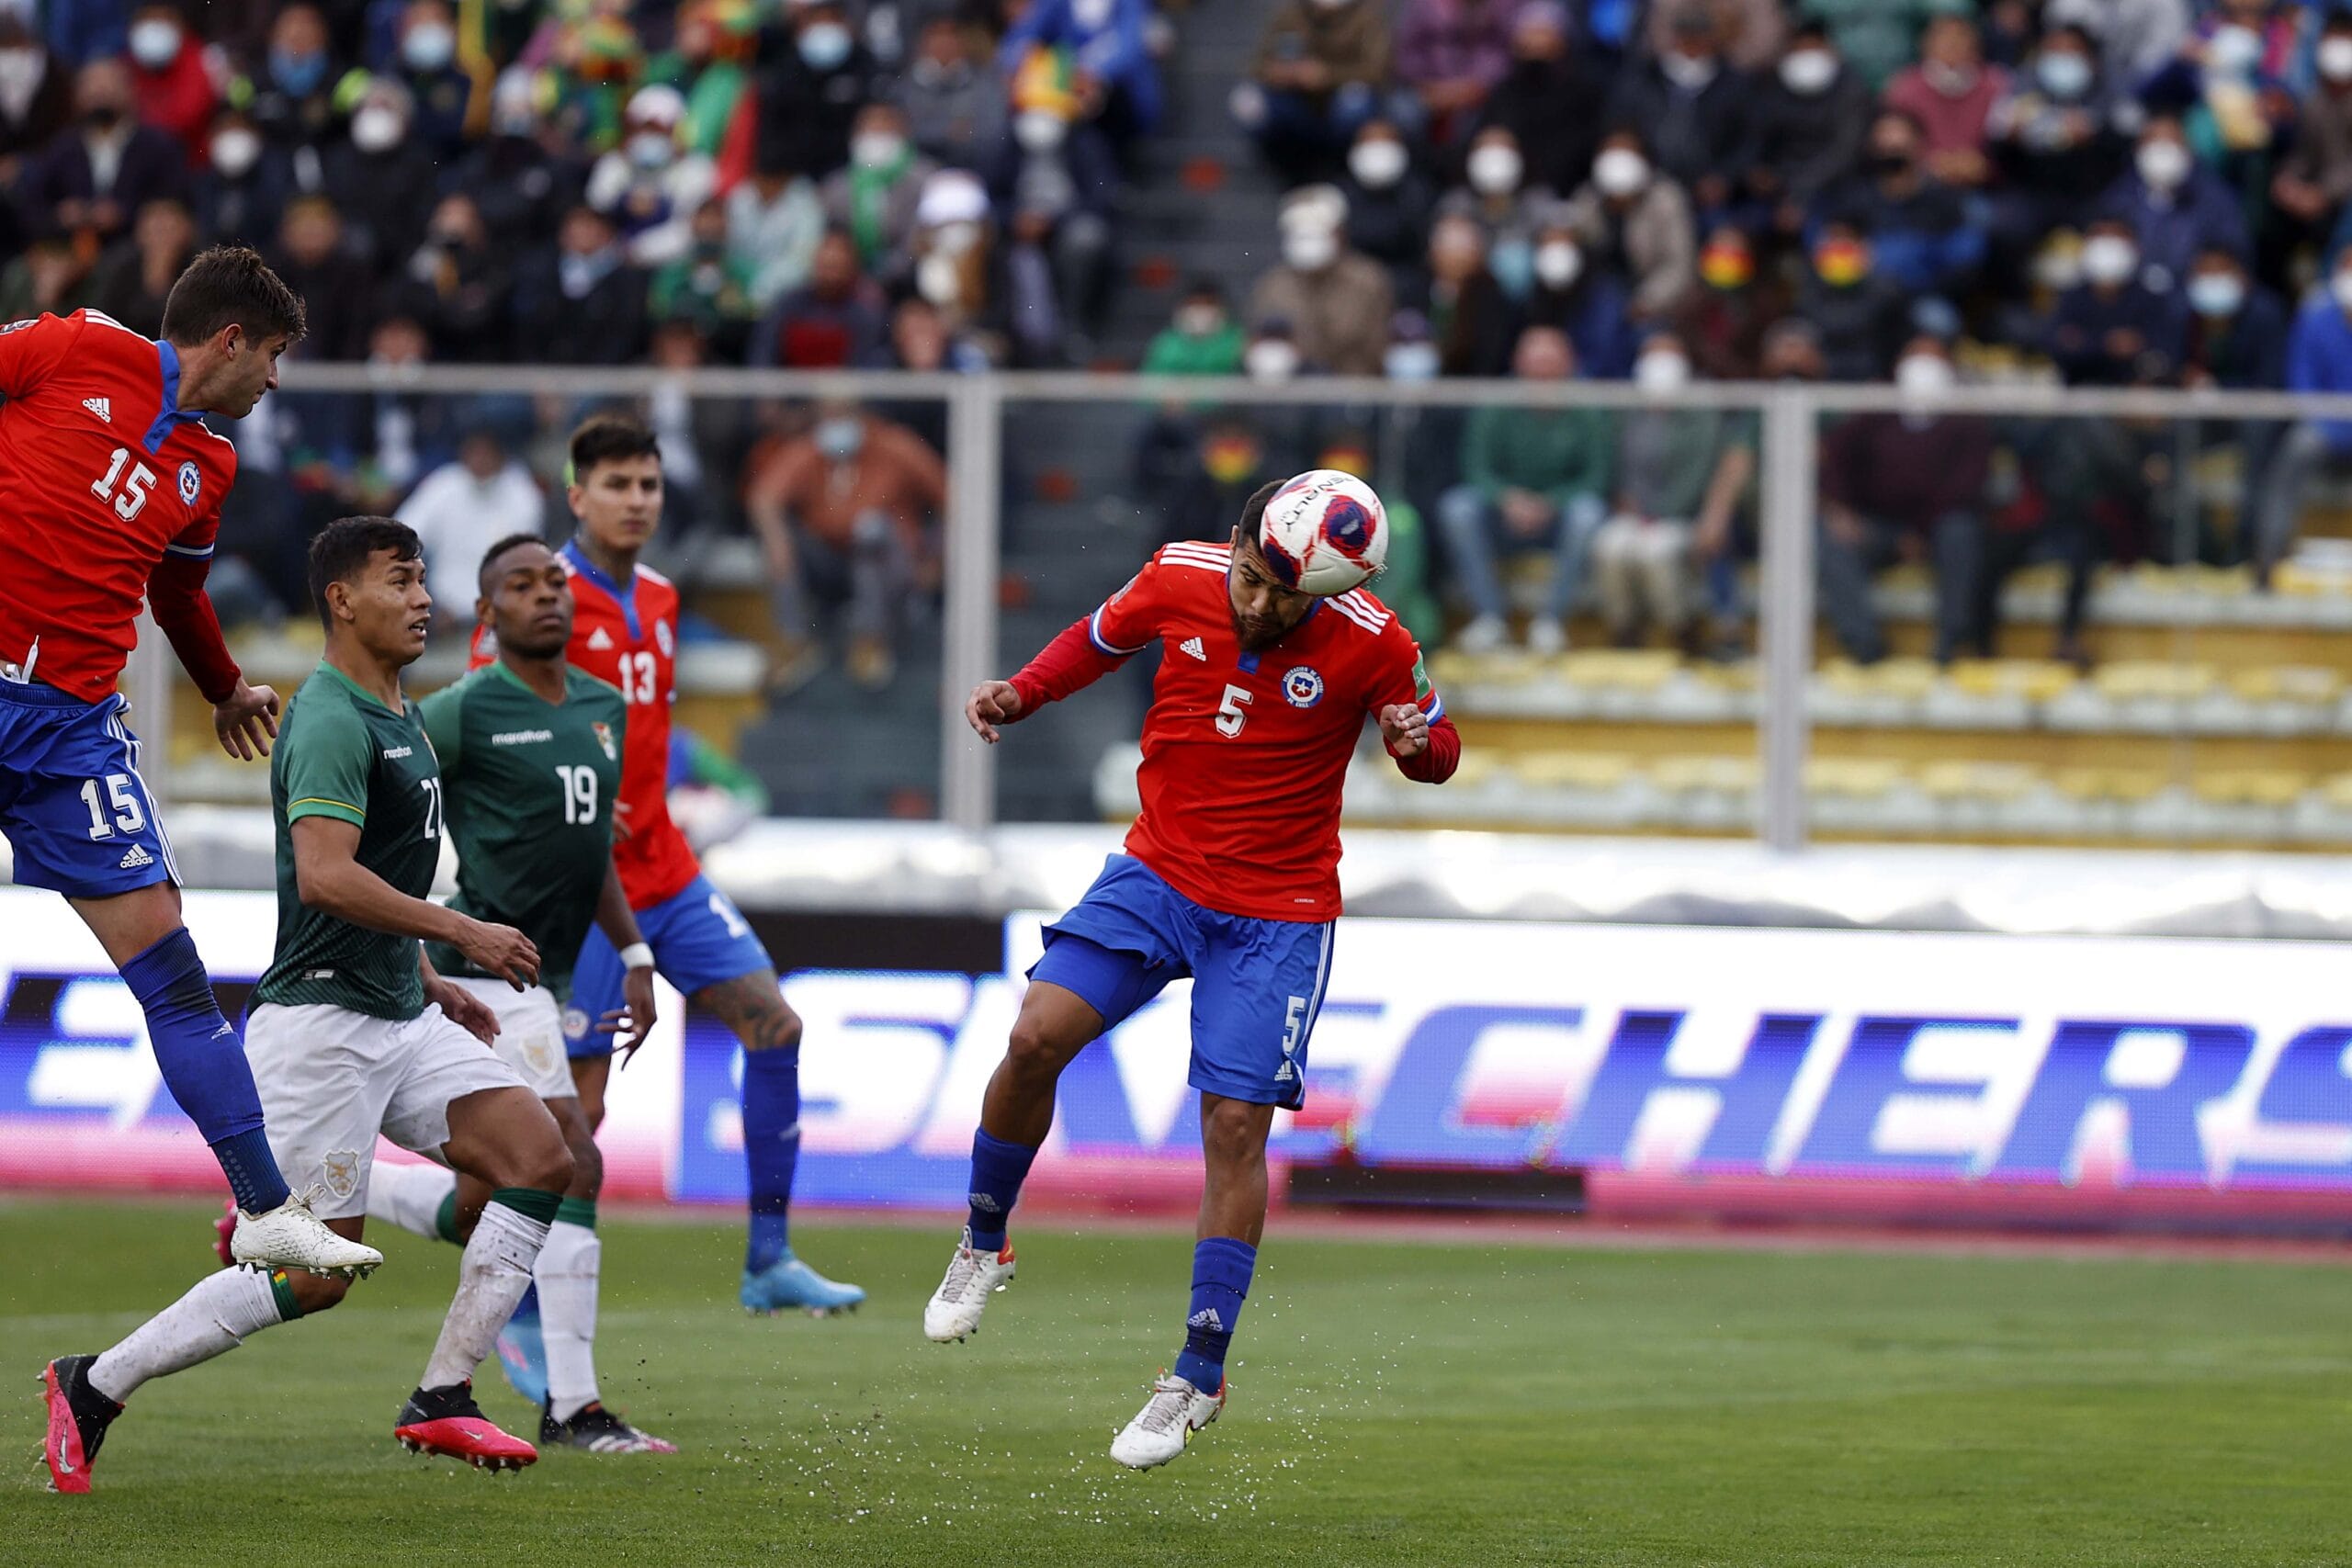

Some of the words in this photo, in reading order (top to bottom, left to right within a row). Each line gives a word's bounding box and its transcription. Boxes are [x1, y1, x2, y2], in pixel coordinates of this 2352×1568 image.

[91, 447, 157, 522] 15
[617, 650, 656, 704] 13
[492, 729, 553, 747] marathon
[1215, 683, 1253, 739] 5
[81, 773, 146, 840] 15
[421, 776, 442, 839] 21
[555, 765, 598, 824] 19
[119, 856, 153, 869] adidas
[1283, 995, 1306, 1056] 5
